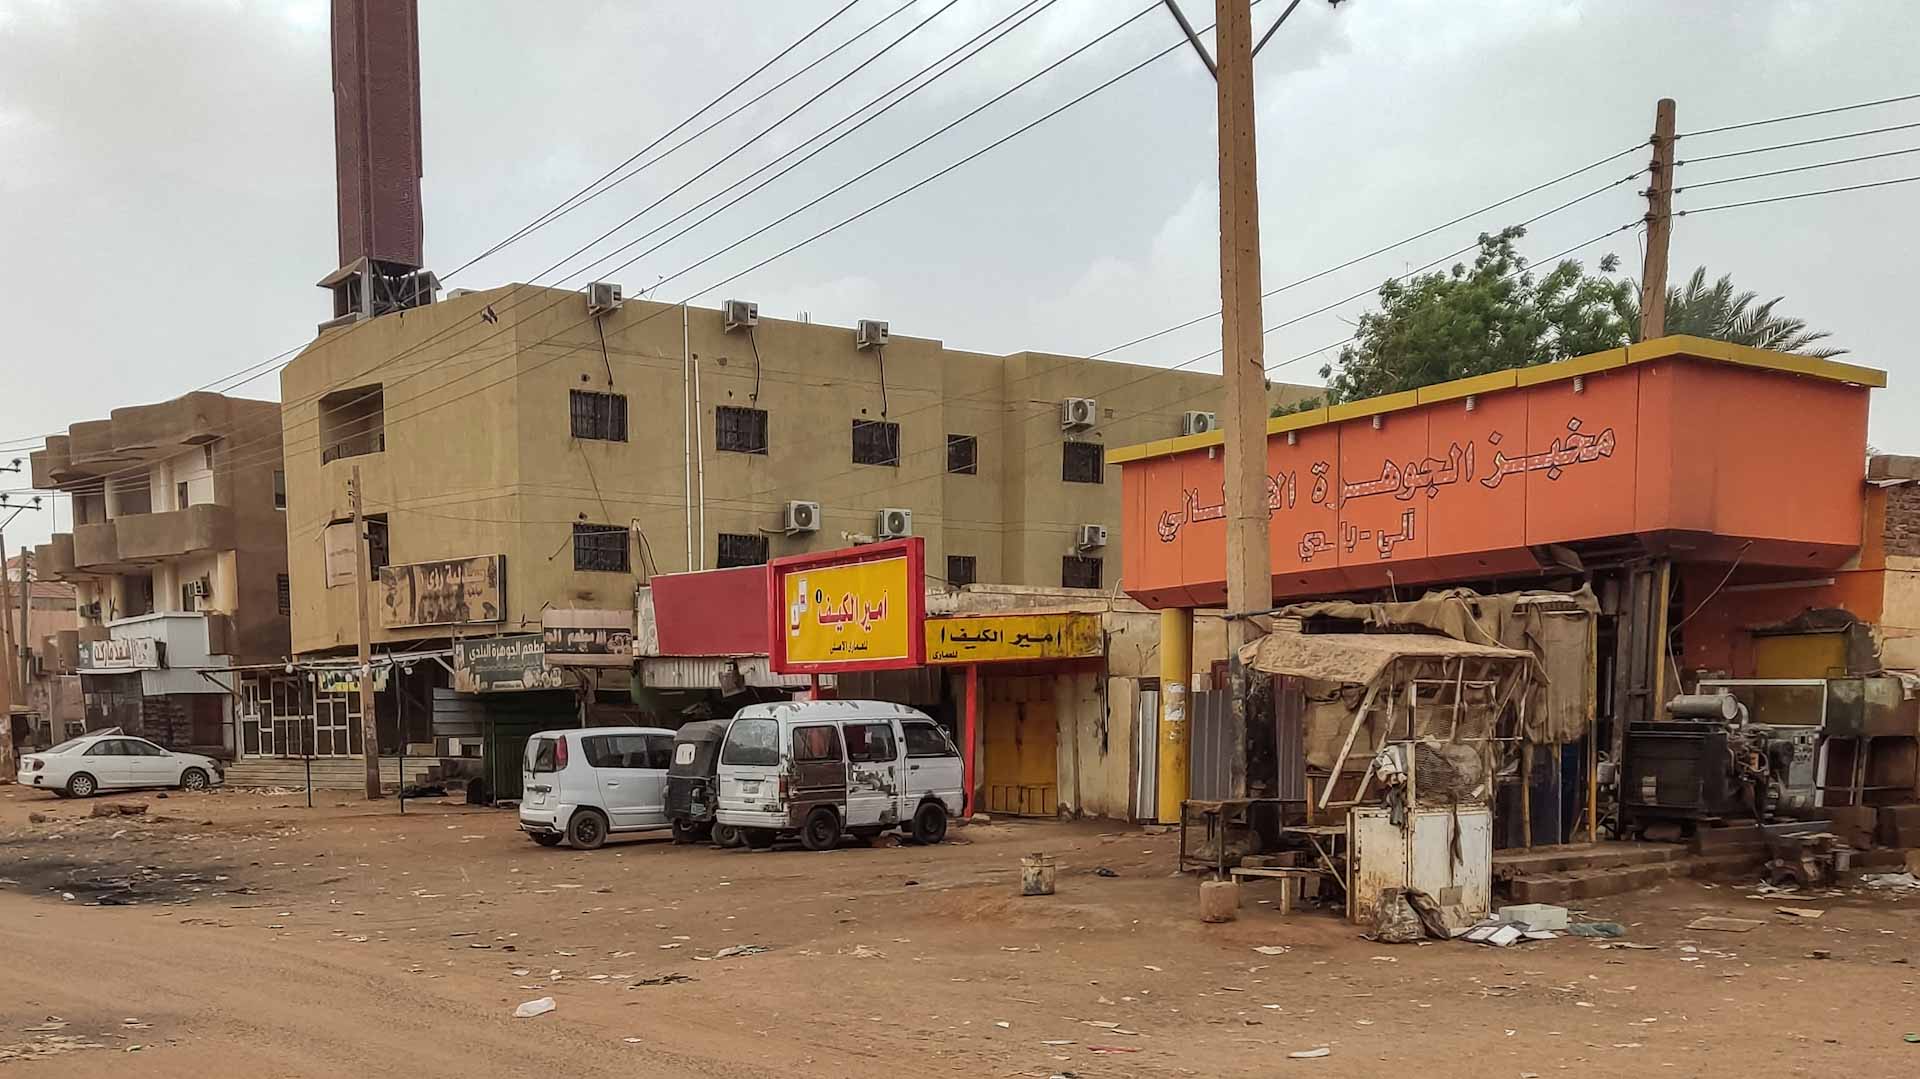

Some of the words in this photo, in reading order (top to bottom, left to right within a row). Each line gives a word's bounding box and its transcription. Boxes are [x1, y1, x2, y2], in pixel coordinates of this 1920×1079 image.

[1481, 417, 1616, 488] مخبز
[1312, 440, 1475, 510] الجوهرة
[818, 591, 860, 632] الكيف
[492, 641, 521, 661] الجوهرة
[950, 627, 1004, 649] الكيف
